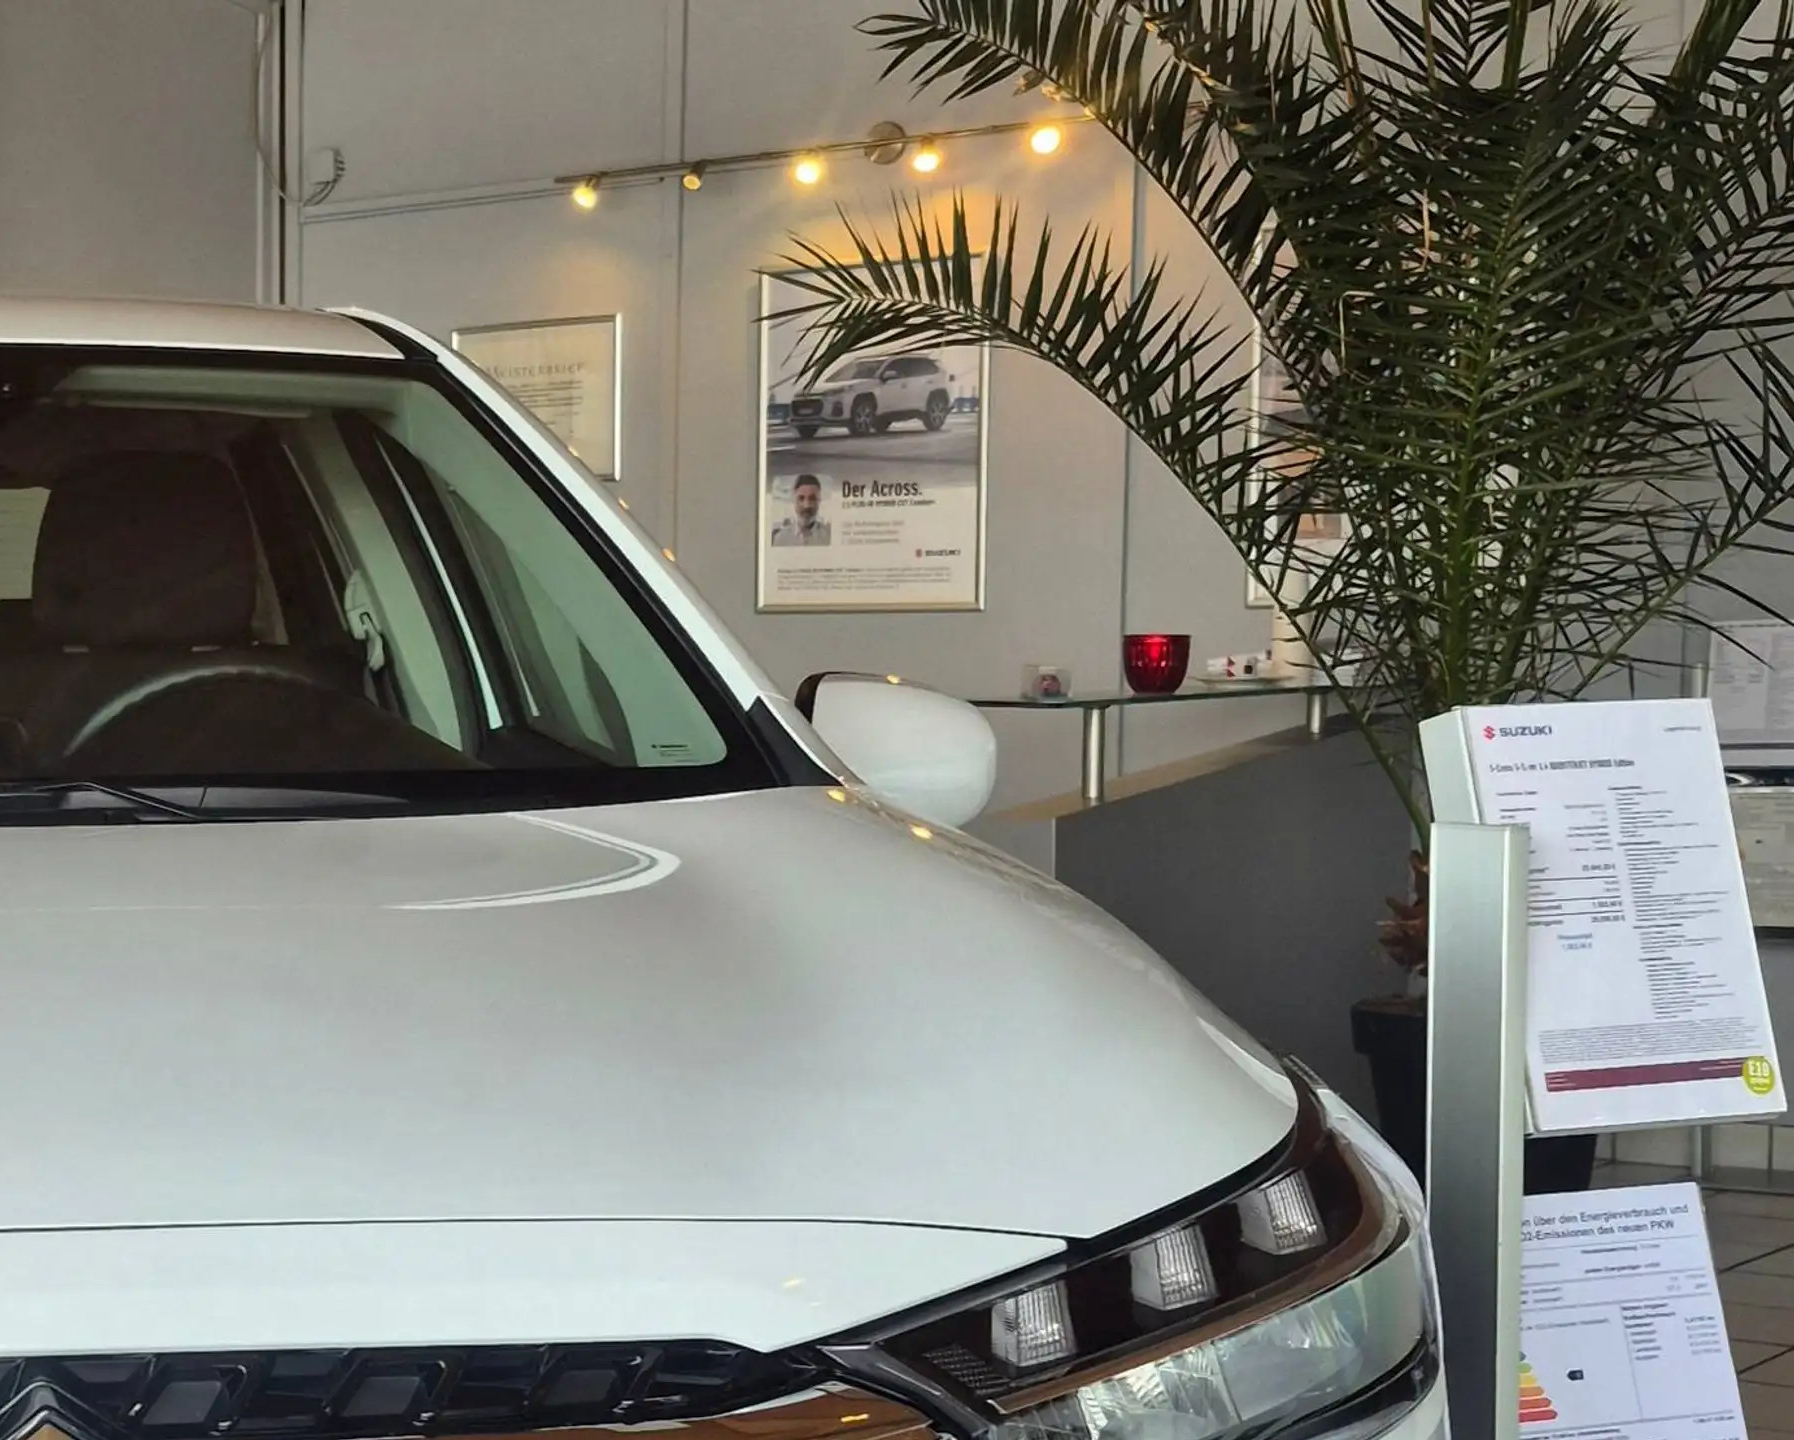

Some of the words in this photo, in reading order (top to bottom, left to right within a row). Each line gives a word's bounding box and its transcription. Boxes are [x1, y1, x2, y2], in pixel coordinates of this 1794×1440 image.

[842, 480, 866, 498] Der
[870, 480, 923, 497] Across.
[1498, 725, 1553, 738] SUZUKI
[1533, 1214, 1556, 1226] über
[1559, 1213, 1579, 1224] den
[1580, 1205, 1668, 1223] Energieverbrauch
[1670, 1203, 1689, 1215] und
[1597, 1225, 1615, 1235] des
[1650, 1219, 1674, 1230] PKW
